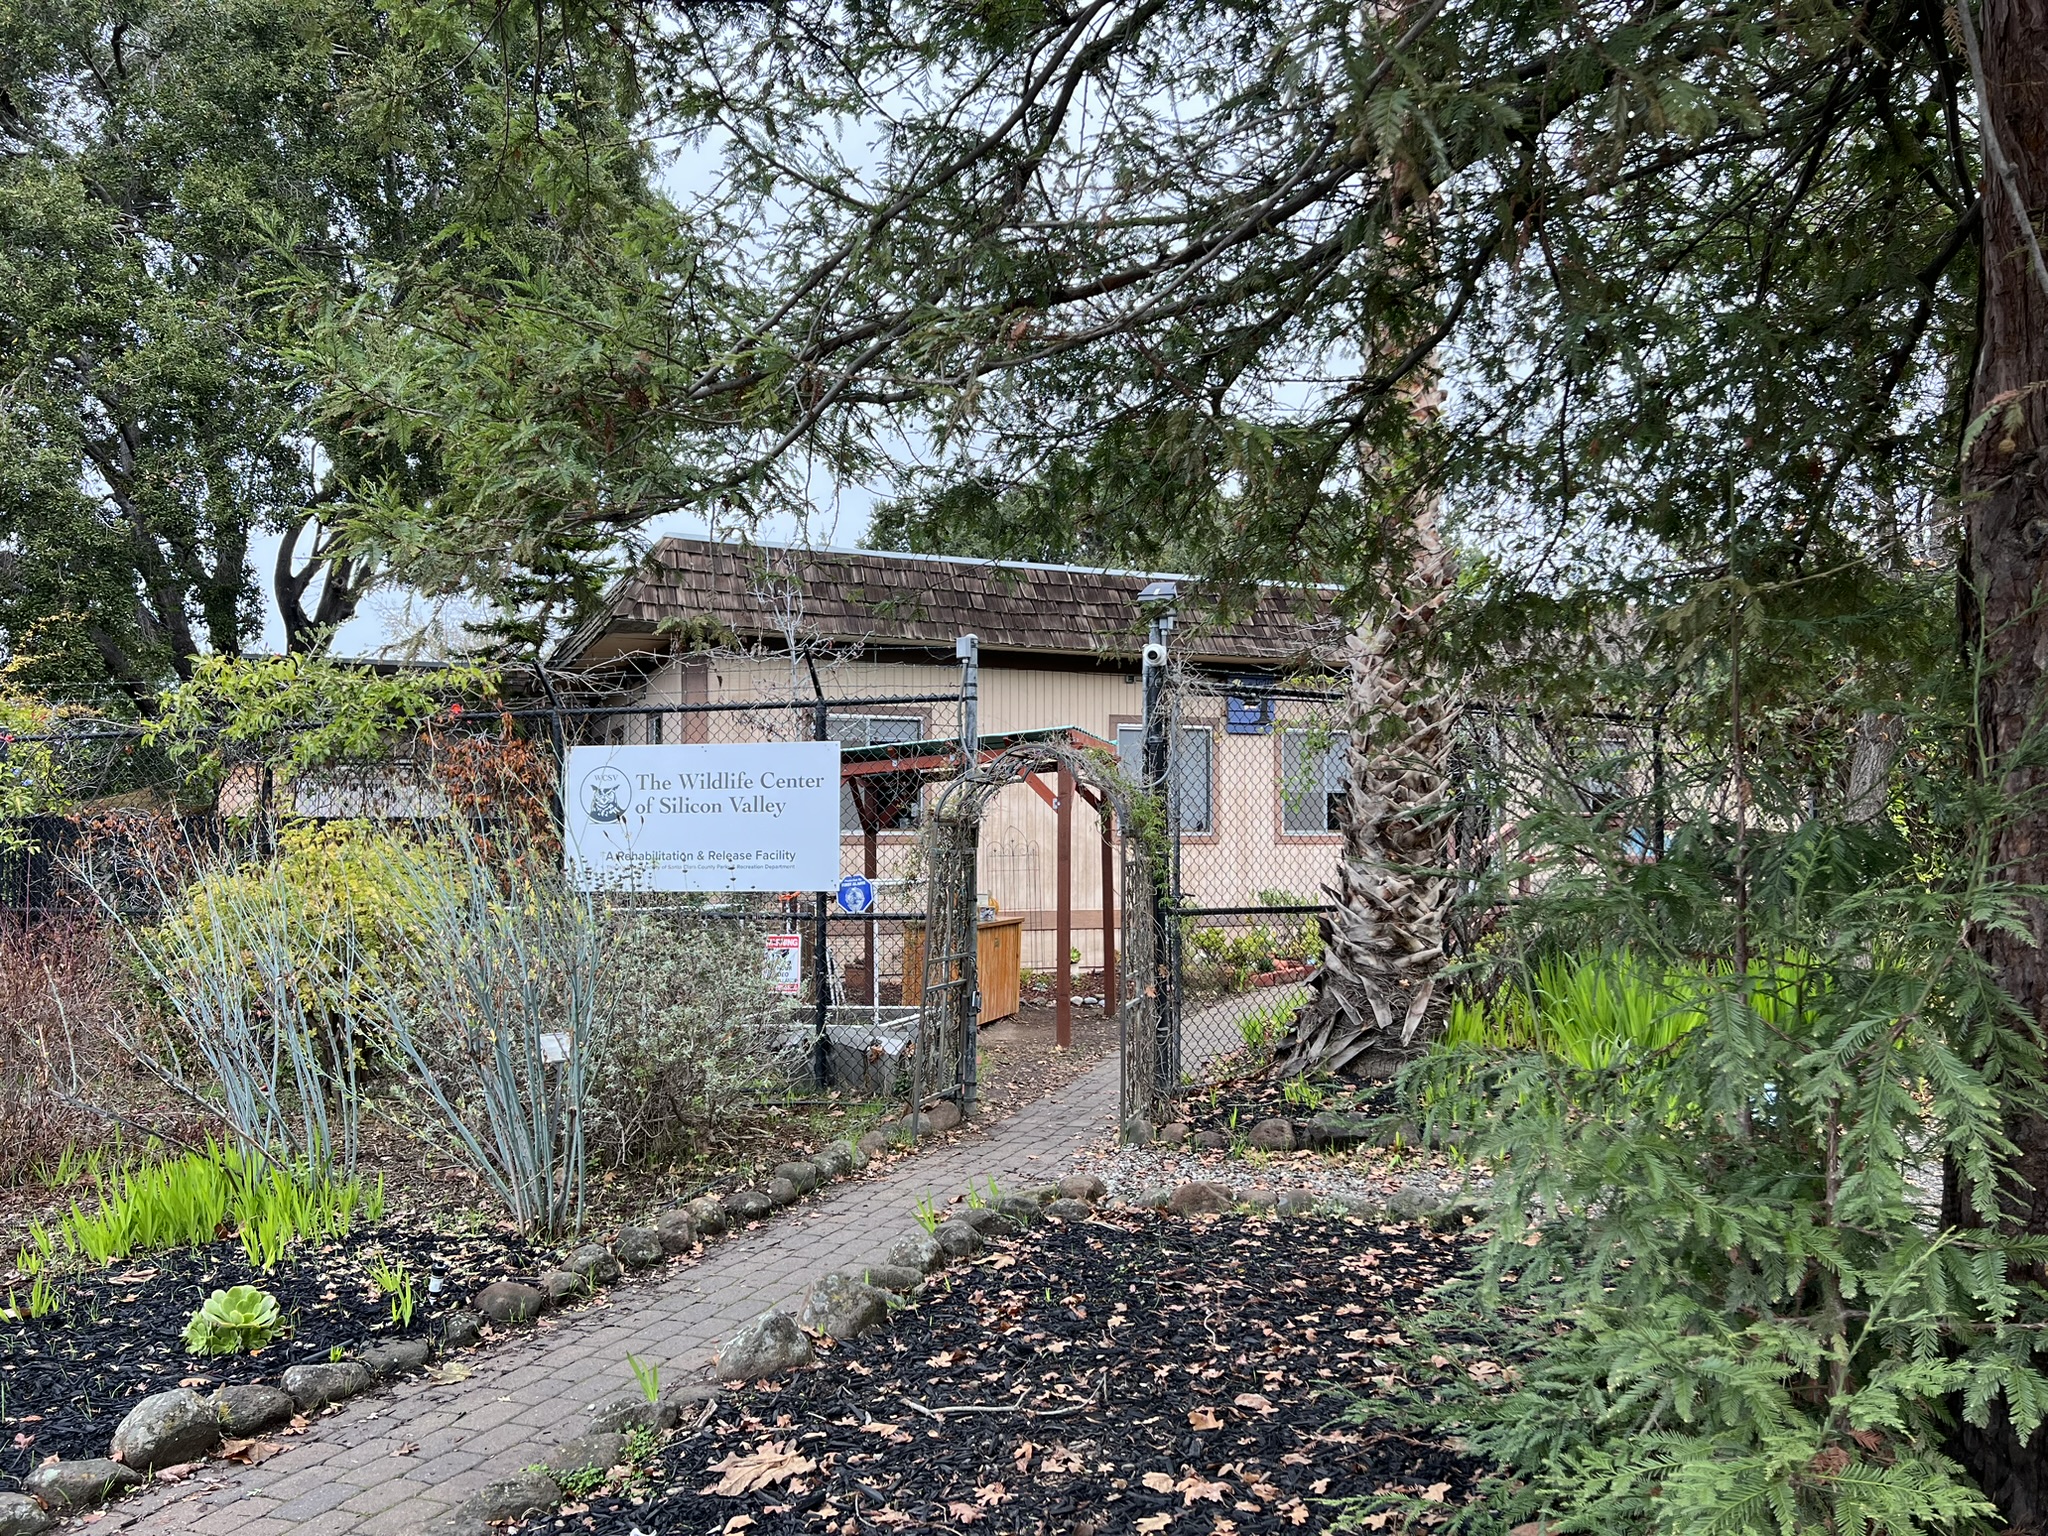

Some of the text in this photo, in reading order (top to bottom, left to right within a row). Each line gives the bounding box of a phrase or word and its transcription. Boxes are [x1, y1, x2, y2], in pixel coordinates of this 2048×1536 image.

[594, 774, 619, 782] WCSV
[635, 771, 825, 790] The Wildlife Center
[635, 795, 787, 818] of Silicon Valley
[605, 849, 796, 862] A Rehabilitation & Release Facility
